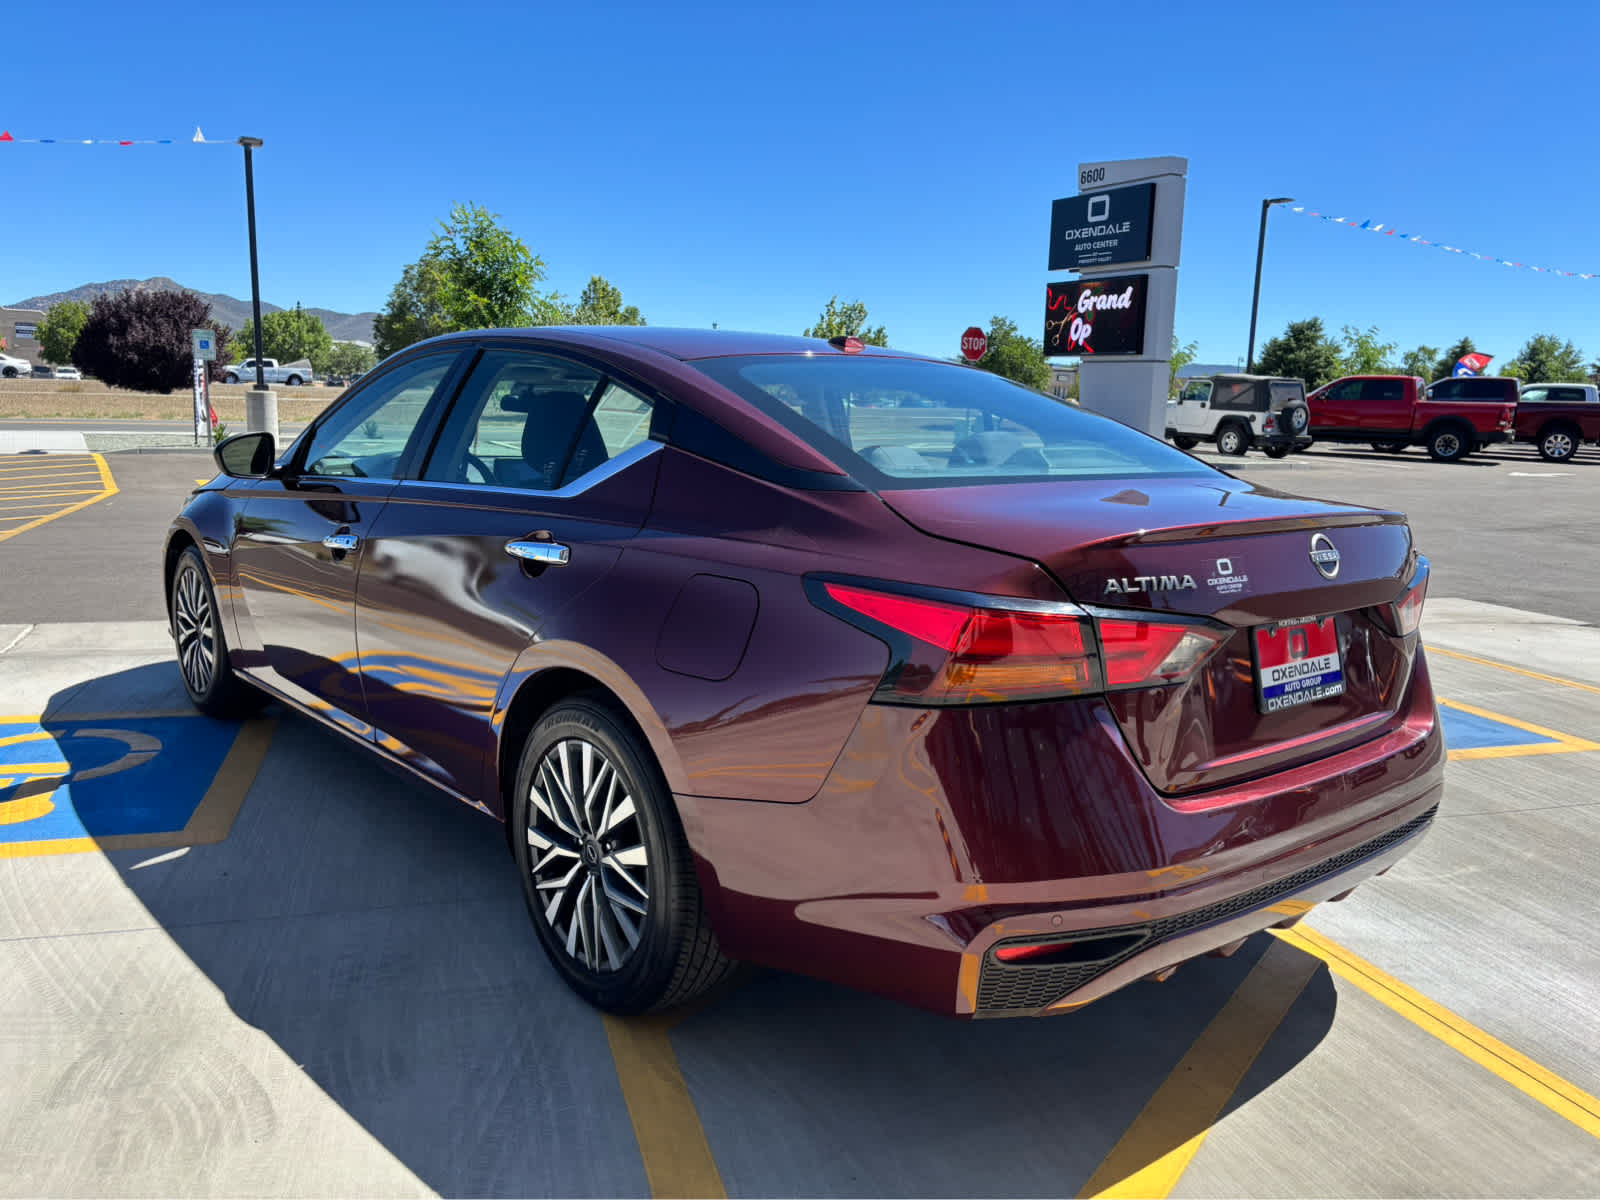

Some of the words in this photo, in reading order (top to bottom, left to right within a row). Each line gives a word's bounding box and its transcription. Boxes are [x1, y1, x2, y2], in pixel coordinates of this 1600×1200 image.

[1080, 167, 1105, 185] 6600
[1065, 221, 1131, 241] OXENDALE
[1074, 242, 1092, 251] AUTO
[1093, 239, 1119, 249] CENTER
[1077, 285, 1134, 313] Grand
[1070, 317, 1093, 346] Op
[961, 336, 985, 351] STOP
[1103, 574, 1198, 595] ALTIMA
[1271, 657, 1331, 682] OXENDALE
[1284, 680, 1301, 693] AUTO
[1301, 676, 1323, 688] GROUP
[1268, 683, 1343, 711] OXENDALE.com
